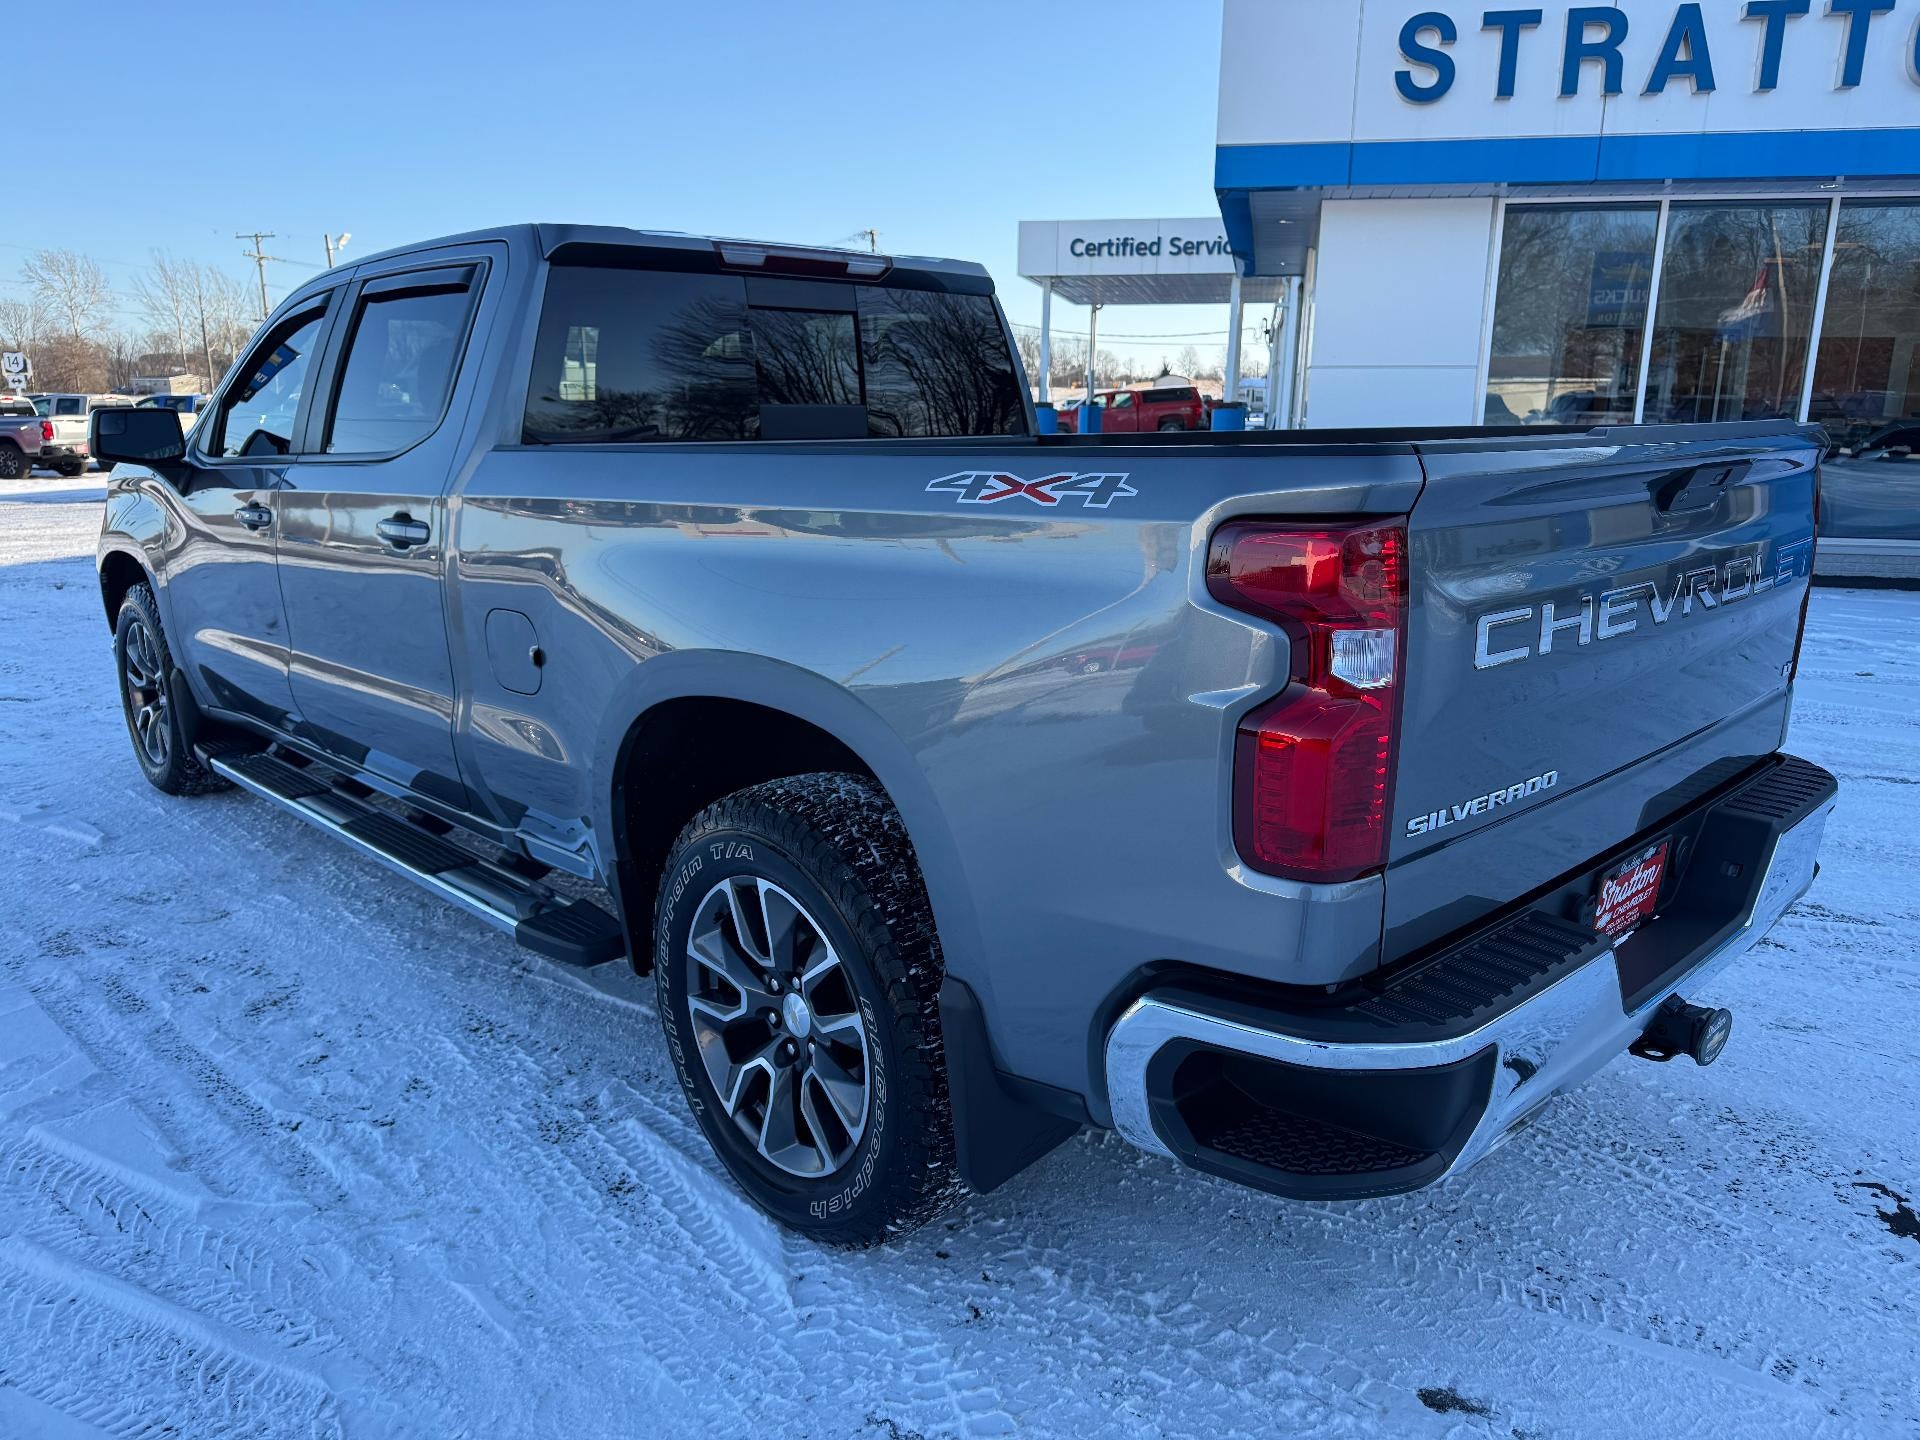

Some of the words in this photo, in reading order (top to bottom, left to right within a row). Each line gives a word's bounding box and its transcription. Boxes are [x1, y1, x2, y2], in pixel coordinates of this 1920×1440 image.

[1394, 0, 1920, 104] STRATT
[1070, 236, 1163, 258] Certified
[1168, 235, 1233, 257] Servic
[7, 356, 20, 368] 14
[1473, 537, 1813, 670] CHEVROLET
[1405, 770, 1559, 838] SILVERADO
[710, 842, 754, 861] T/A
[1595, 863, 1661, 917] Stratton
[809, 995, 887, 1220] BFGoodrich
